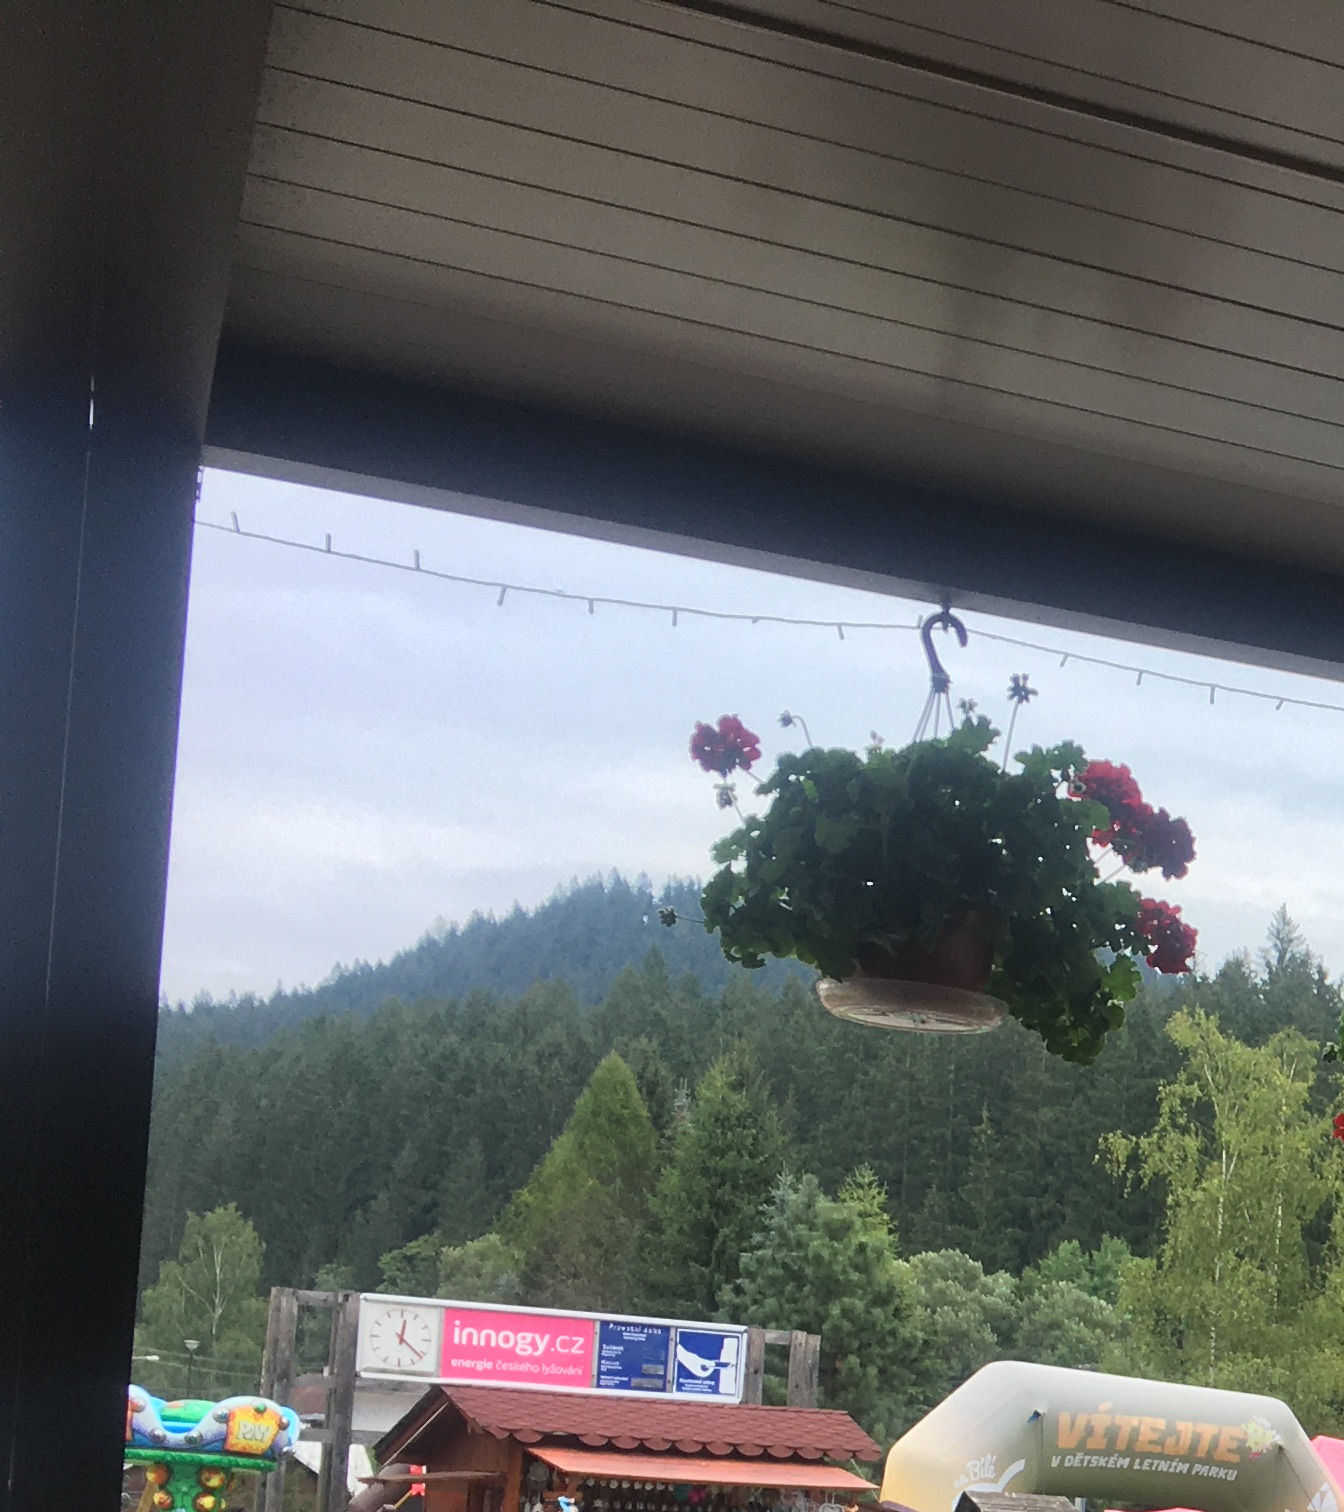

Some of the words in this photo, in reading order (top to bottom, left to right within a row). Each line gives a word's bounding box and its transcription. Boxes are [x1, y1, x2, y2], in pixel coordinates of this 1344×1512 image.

[453, 1320, 585, 1356] innogy.cz
[451, 1358, 493, 1371] energie
[495, 1359, 540, 1373] českého
[541, 1363, 583, 1376] lyžování
[1057, 1401, 1248, 1463] VÍTEJTE
[966, 1453, 997, 1481] Bílé
[1050, 1455, 1061, 1467] V
[1064, 1452, 1130, 1469] DĚTSKÉM
[1133, 1457, 1189, 1475] LETNÍM
[1191, 1463, 1238, 1481] PARKU
